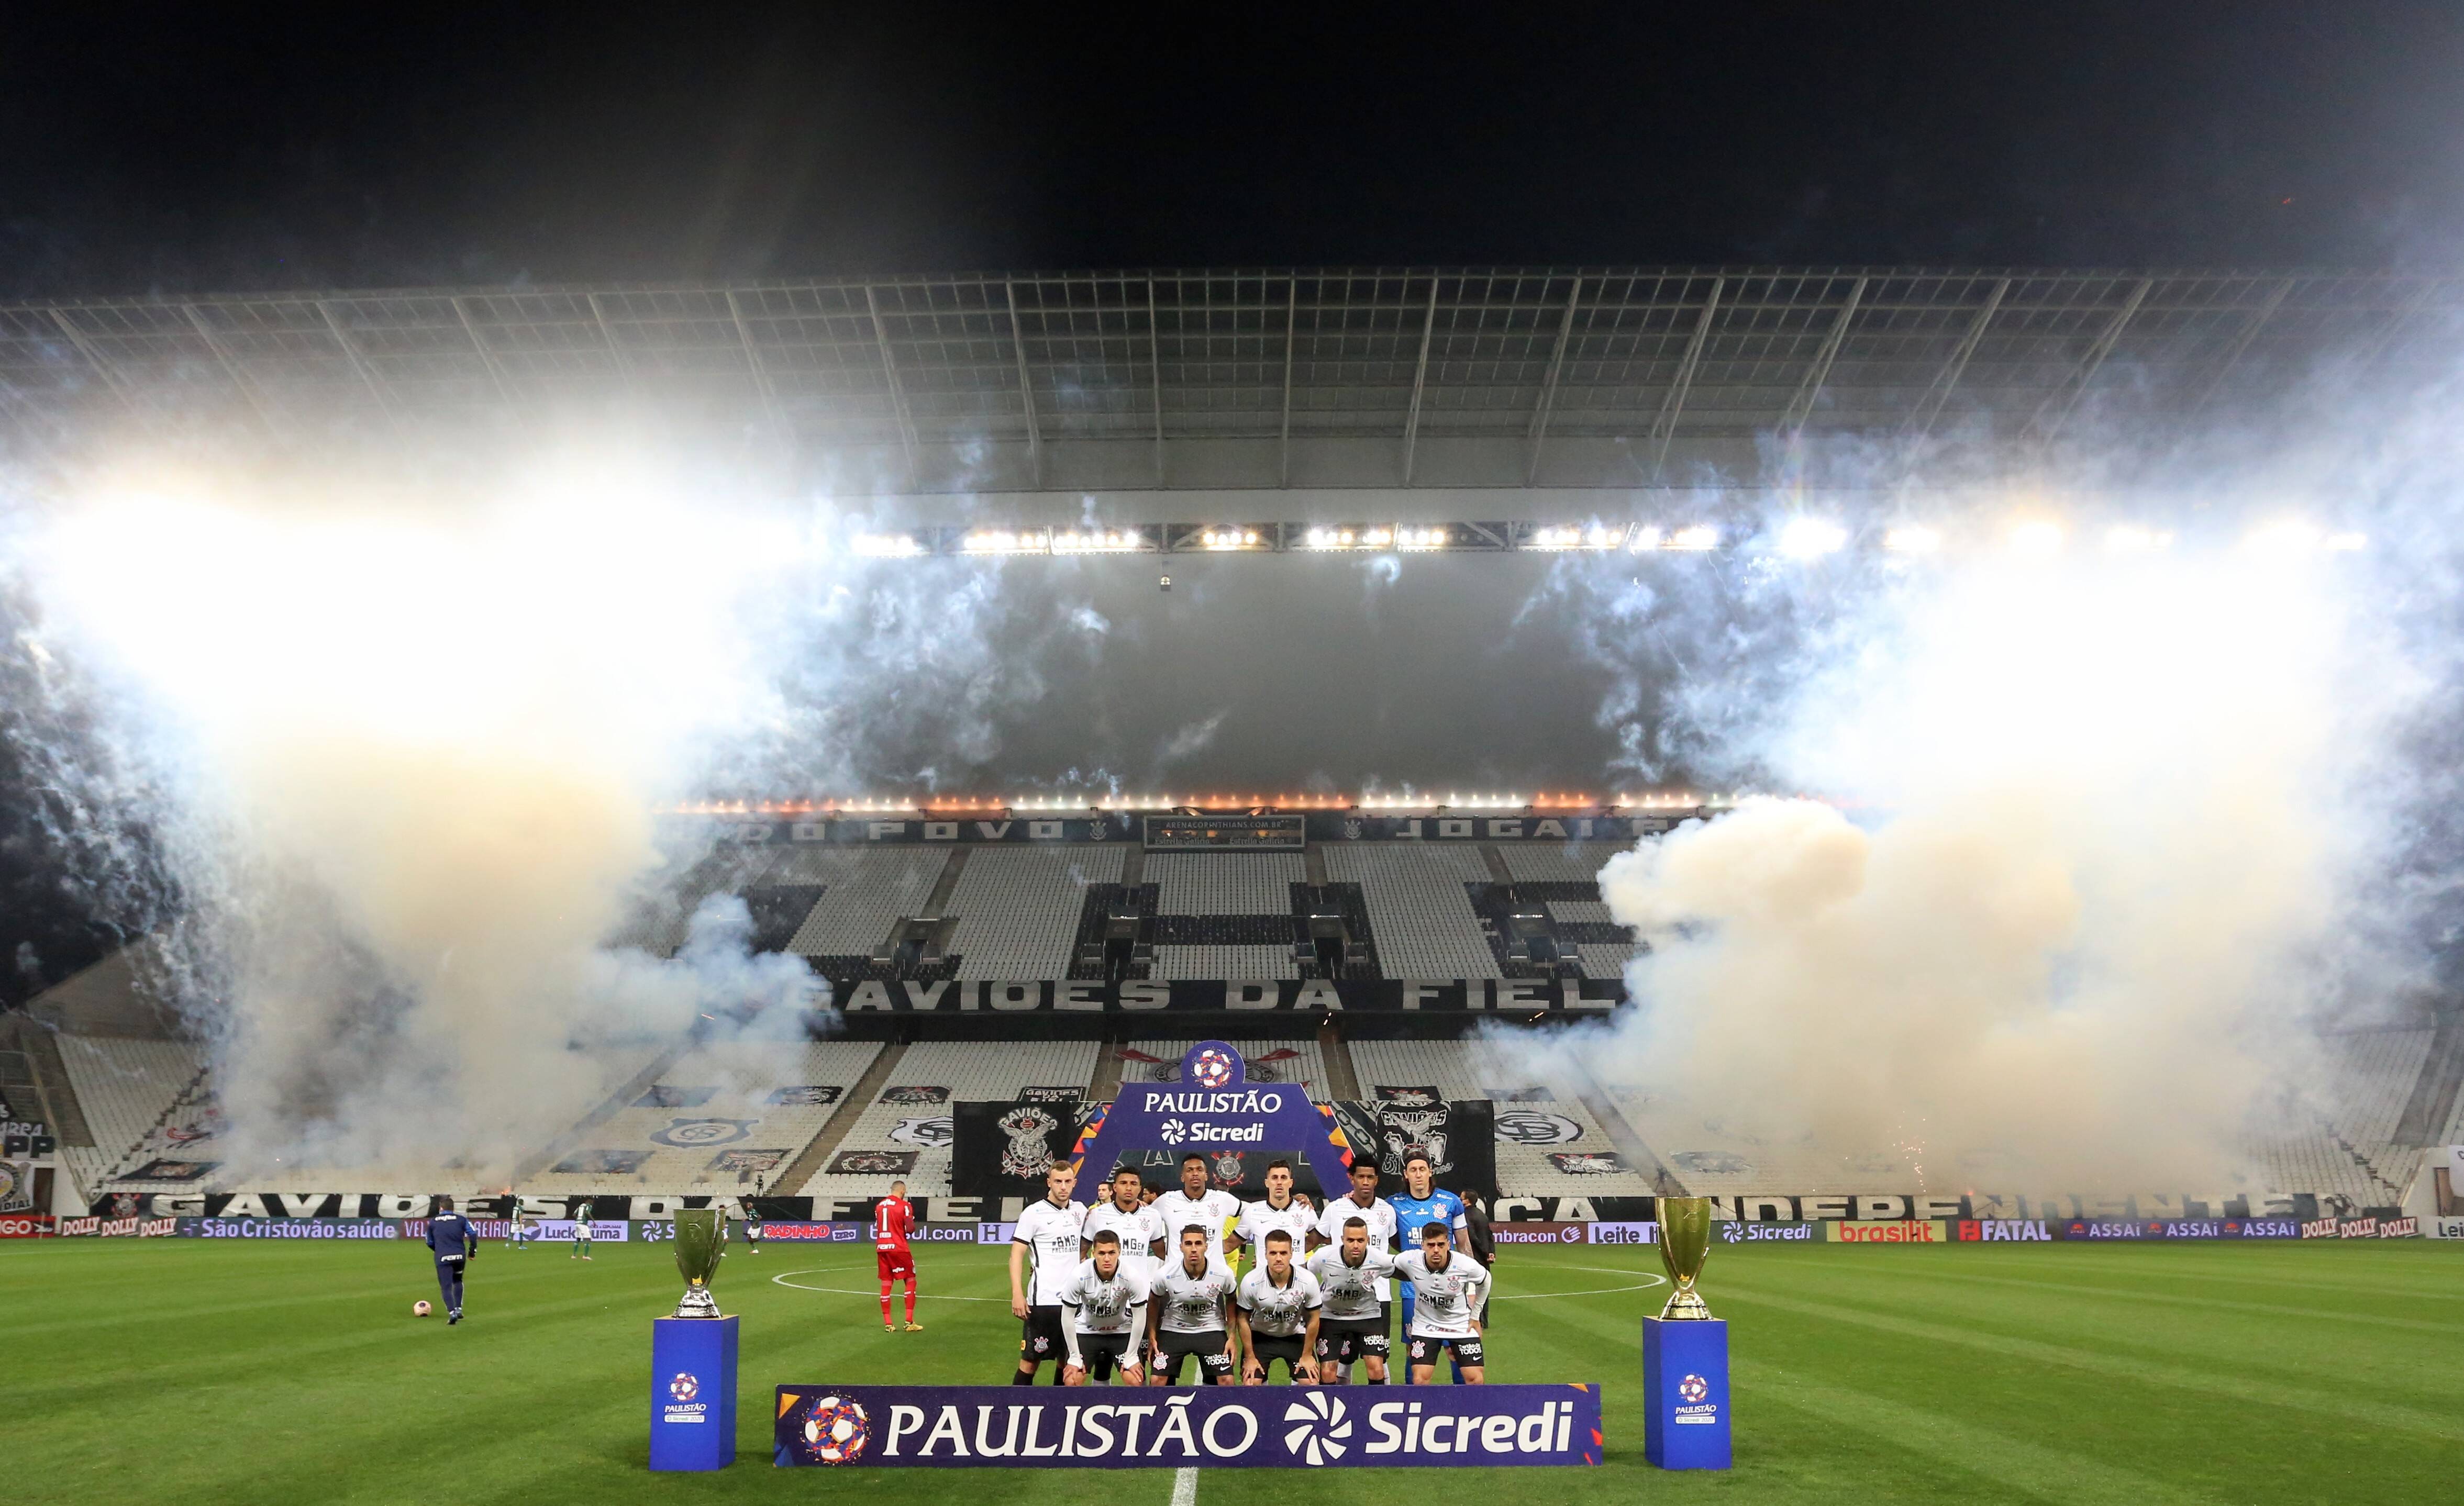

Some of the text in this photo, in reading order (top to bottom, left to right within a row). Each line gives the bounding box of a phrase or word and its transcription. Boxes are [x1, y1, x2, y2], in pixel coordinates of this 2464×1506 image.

[869, 821, 1063, 840] POVO
[1396, 819, 1593, 837] JOGAI
[1225, 979, 1344, 1010] DA
[1402, 978, 1616, 1010] FIEL
[1144, 1089, 1282, 1113] PAULISTÃO
[1189, 1122, 1264, 1142] Sicredi
[63, 1217, 177, 1237] DOLLY DOLLY DOLLY
[202, 1219, 395, 1239] São Cristóvão saúde
[882, 1208, 887, 1231] 1
[2302, 1217, 2417, 1239] DOLLY DOLLY DOLLY
[764, 1224, 830, 1239] DADINHO
[835, 1231, 854, 1240] ZERO
[1595, 1226, 1640, 1244] Leite
[1747, 1223, 1811, 1240] Sicredi
[1839, 1221, 1933, 1242] brasilit
[1982, 1220, 2051, 1241] FATAL
[664, 1403, 707, 1413] PAULISTÃO
[1675, 1404, 1717, 1414] PAULISTÃO
[882, 1390, 1574, 1457] PAULISTÃO Sicredi
